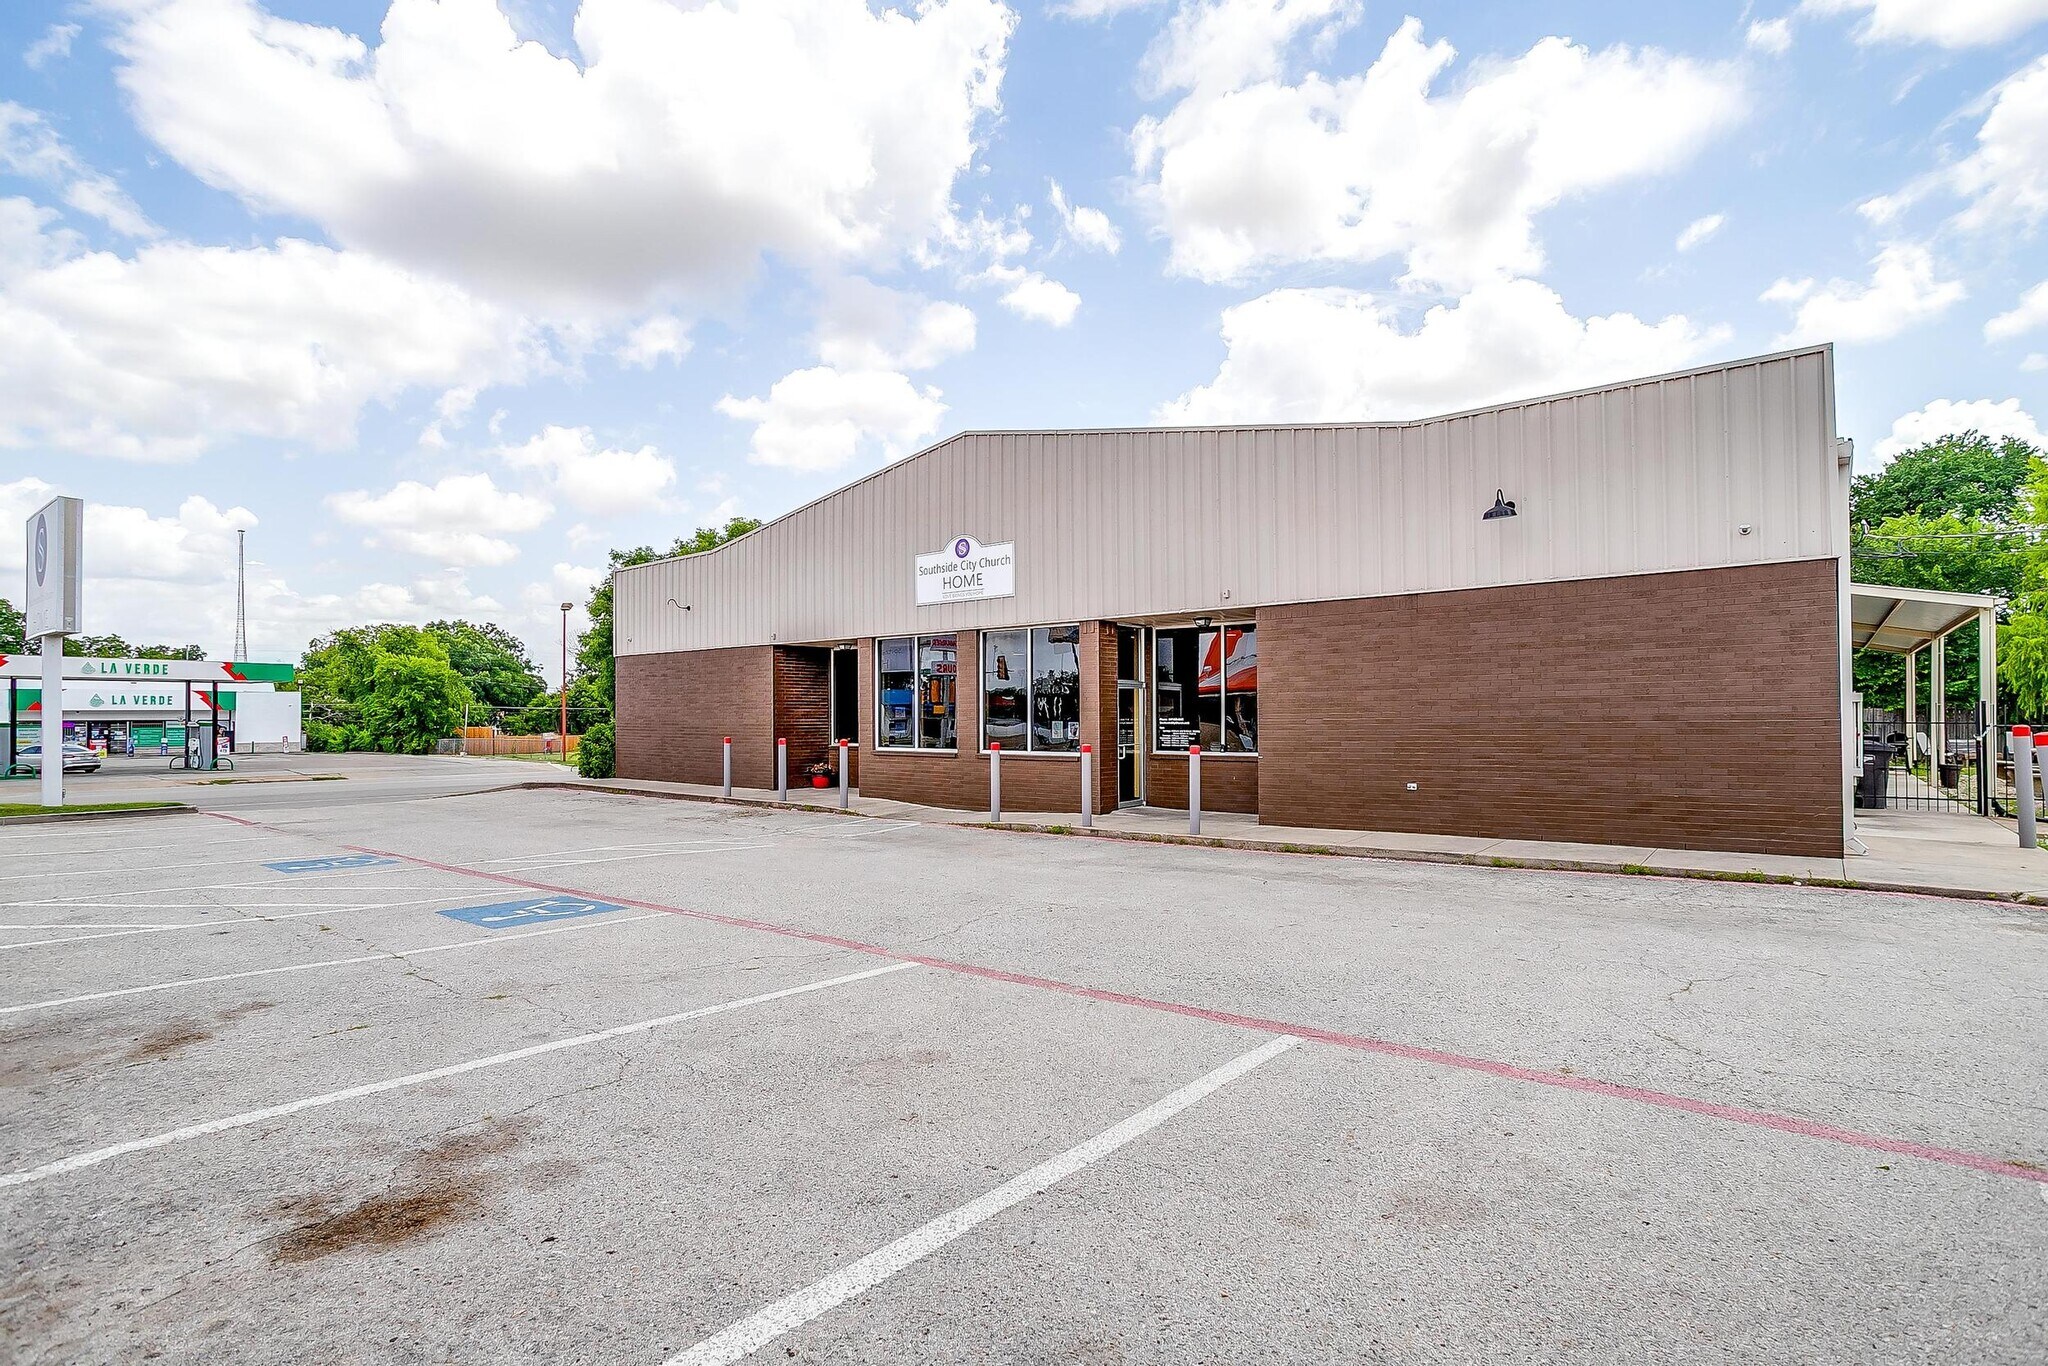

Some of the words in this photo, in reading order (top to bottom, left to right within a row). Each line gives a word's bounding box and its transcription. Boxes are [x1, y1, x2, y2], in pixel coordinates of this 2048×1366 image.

[918, 561, 958, 576] Southside
[960, 560, 977, 572] City
[979, 555, 1010, 568] Church
[943, 573, 983, 589] HOME
[101, 662, 117, 674] LA
[125, 663, 169, 675] VERDE
[111, 695, 126, 705] LA
[133, 695, 173, 706] VERDE
